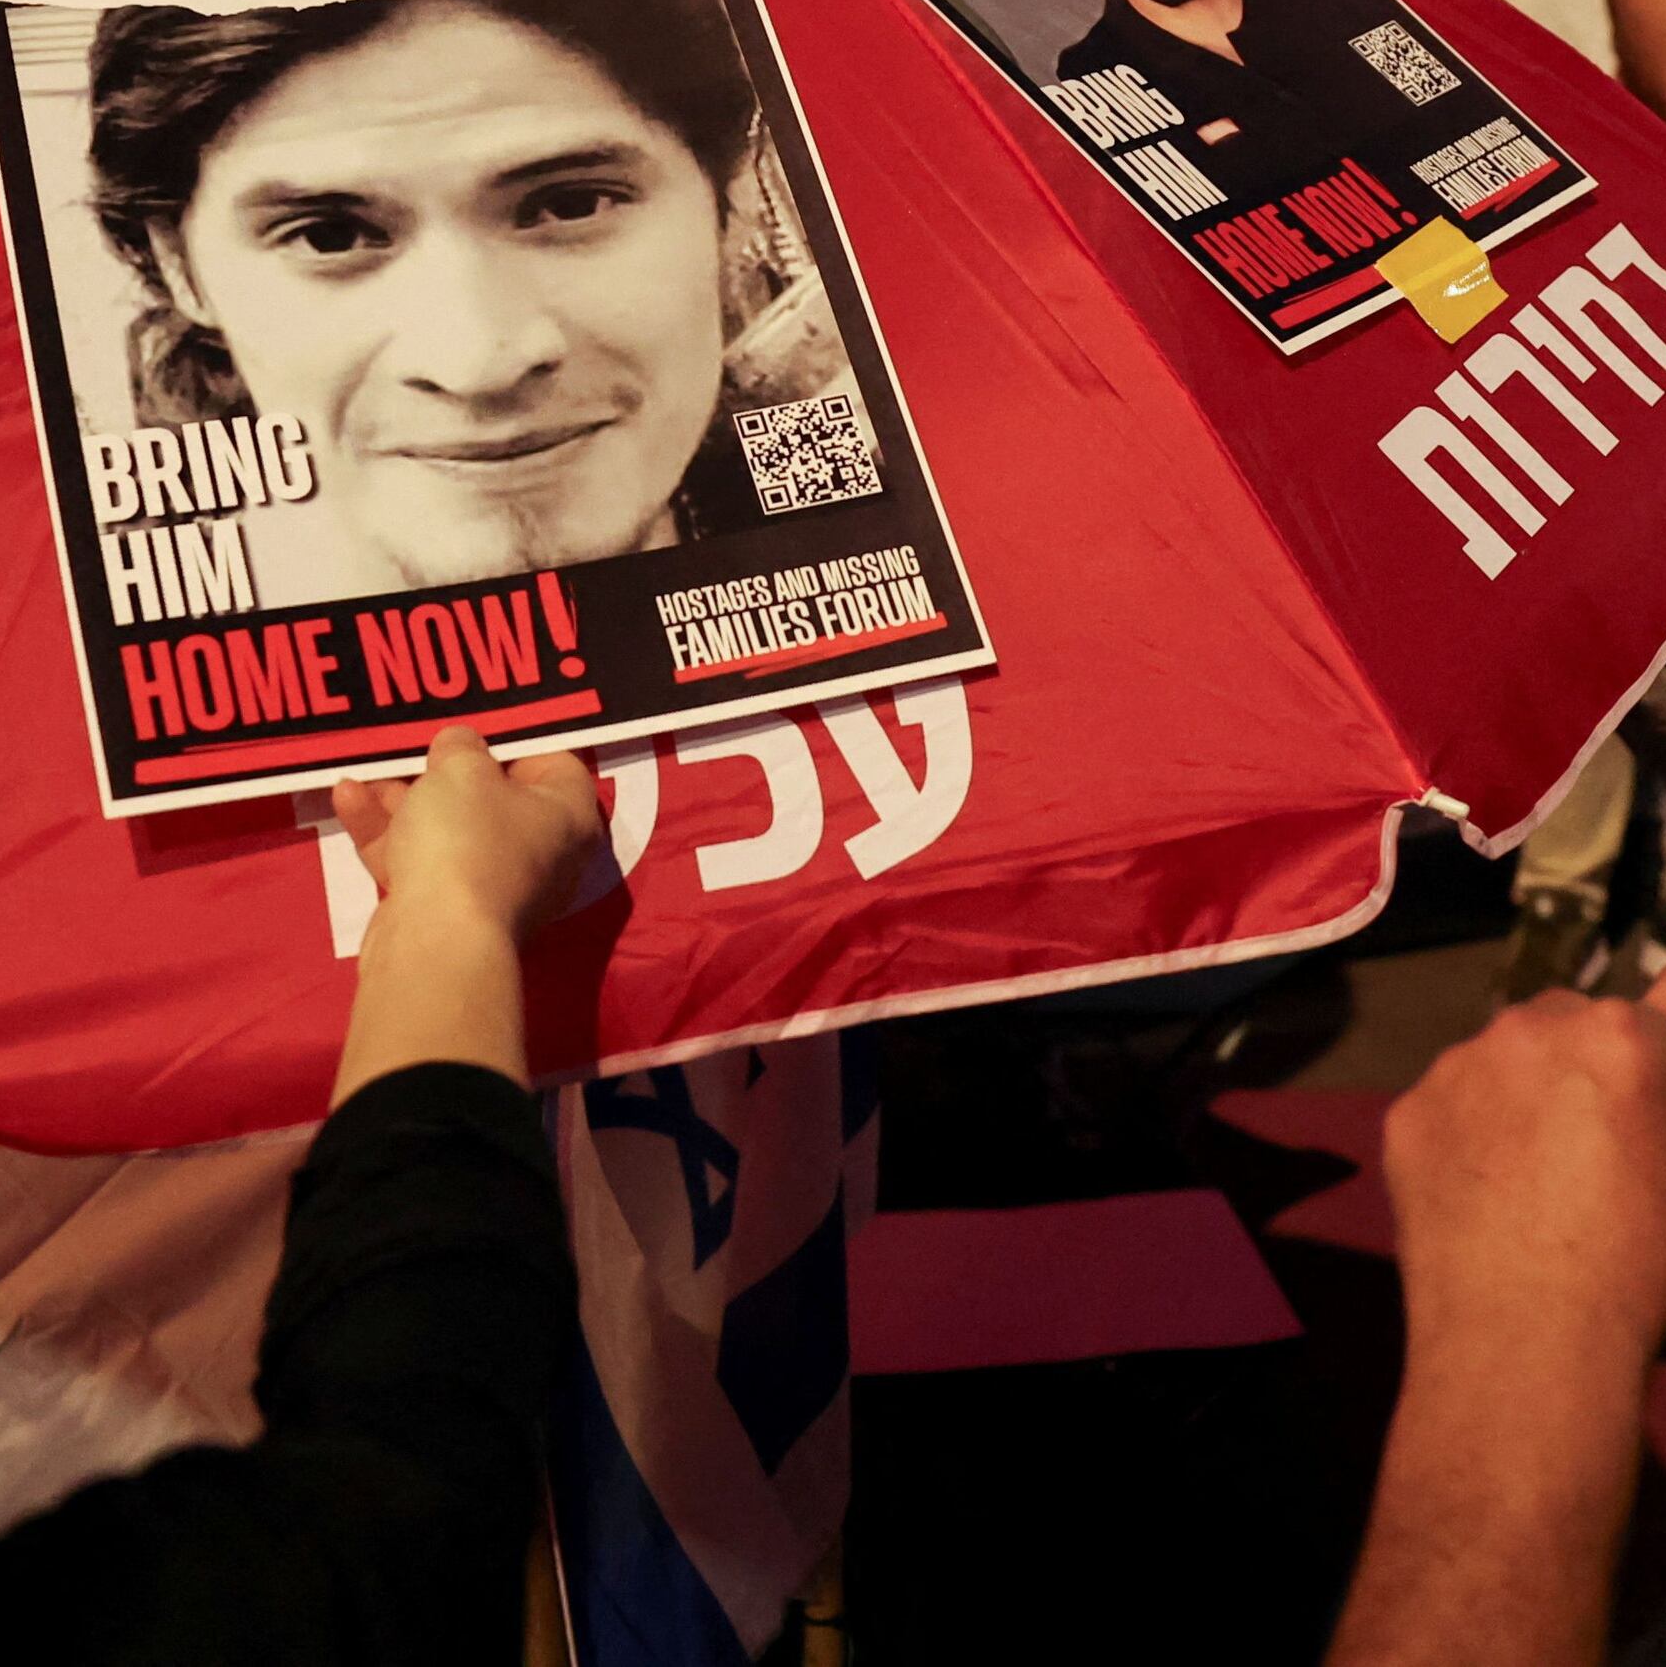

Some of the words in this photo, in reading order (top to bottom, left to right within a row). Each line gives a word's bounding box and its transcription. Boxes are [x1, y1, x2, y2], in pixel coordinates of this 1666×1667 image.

[1039, 64, 1185, 150] BRING
[1112, 139, 1229, 221] HIM
[1409, 144, 1469, 185] HOSTAGES
[1453, 135, 1486, 162] AND
[1431, 158, 1509, 213] FAMILIES
[1486, 134, 1552, 182] FORUM
[1192, 203, 1334, 300] HOME
[1280, 157, 1418, 259] NOW!
[80, 412, 315, 524] BRING
[99, 517, 255, 627] HIM
[655, 575, 773, 626] HOSTAGES
[773, 565, 819, 603] AND
[819, 545, 921, 592] MISSING
[120, 618, 351, 742] HOME
[355, 570, 586, 707] NOW!
[665, 599, 817, 671] FAMILIES
[815, 575, 937, 640] FORUM
